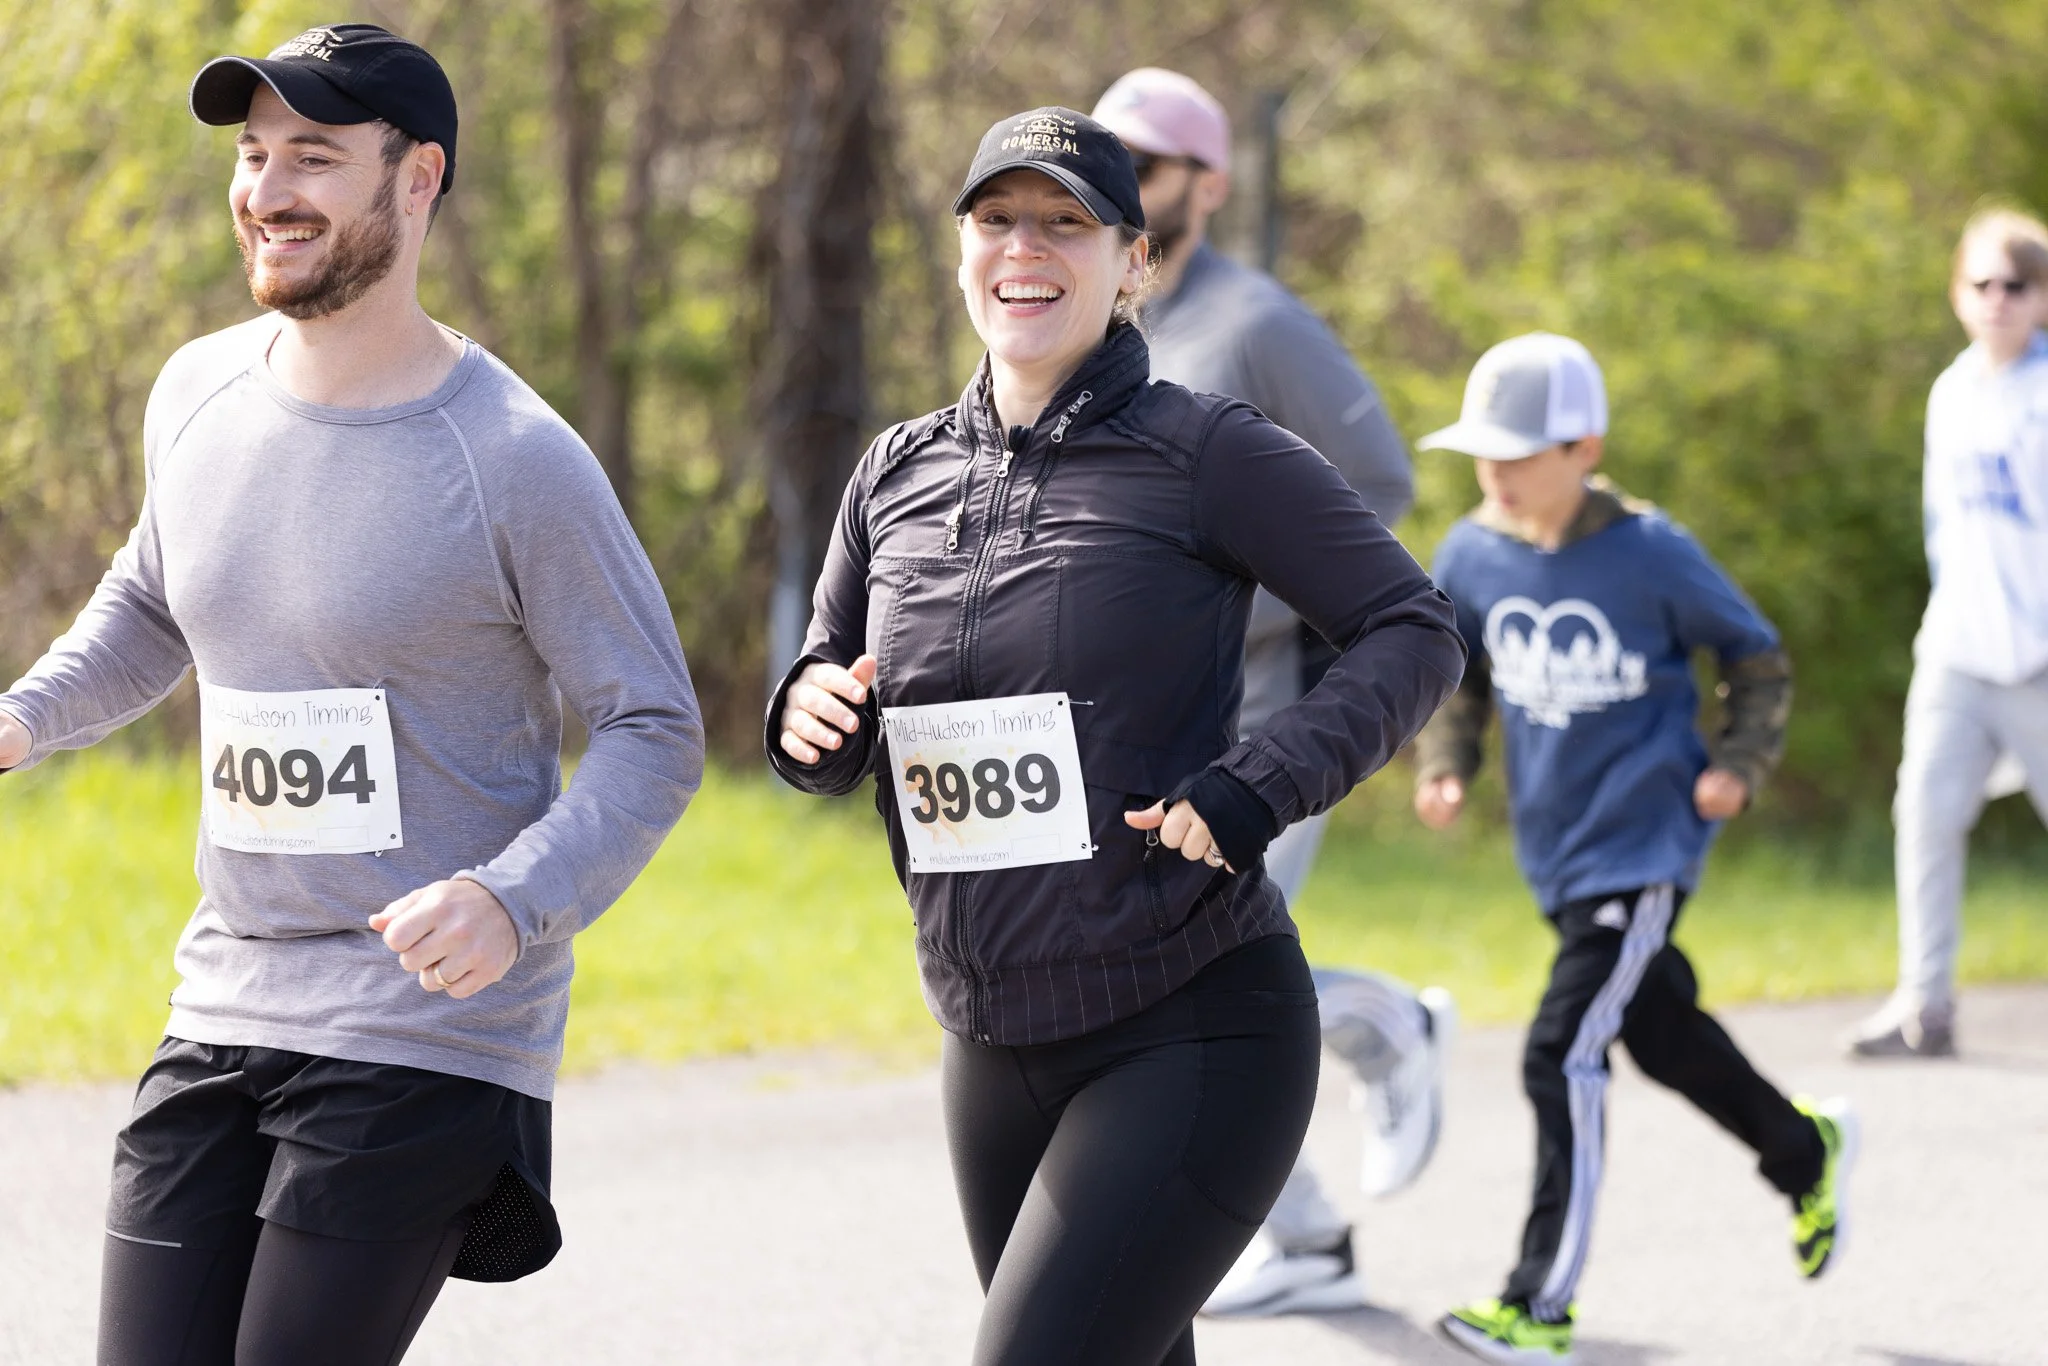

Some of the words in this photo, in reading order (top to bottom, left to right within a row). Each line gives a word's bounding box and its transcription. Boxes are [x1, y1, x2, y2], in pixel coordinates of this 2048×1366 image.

[206, 693, 296, 727] Md-Hudson
[303, 700, 374, 727] Timing
[893, 713, 985, 743] Mid-Hudson
[992, 708, 1056, 735] Timing
[212, 743, 377, 808] 4094
[905, 753, 1061, 824] 3989
[224, 831, 316, 849] mdhudsontiming.com
